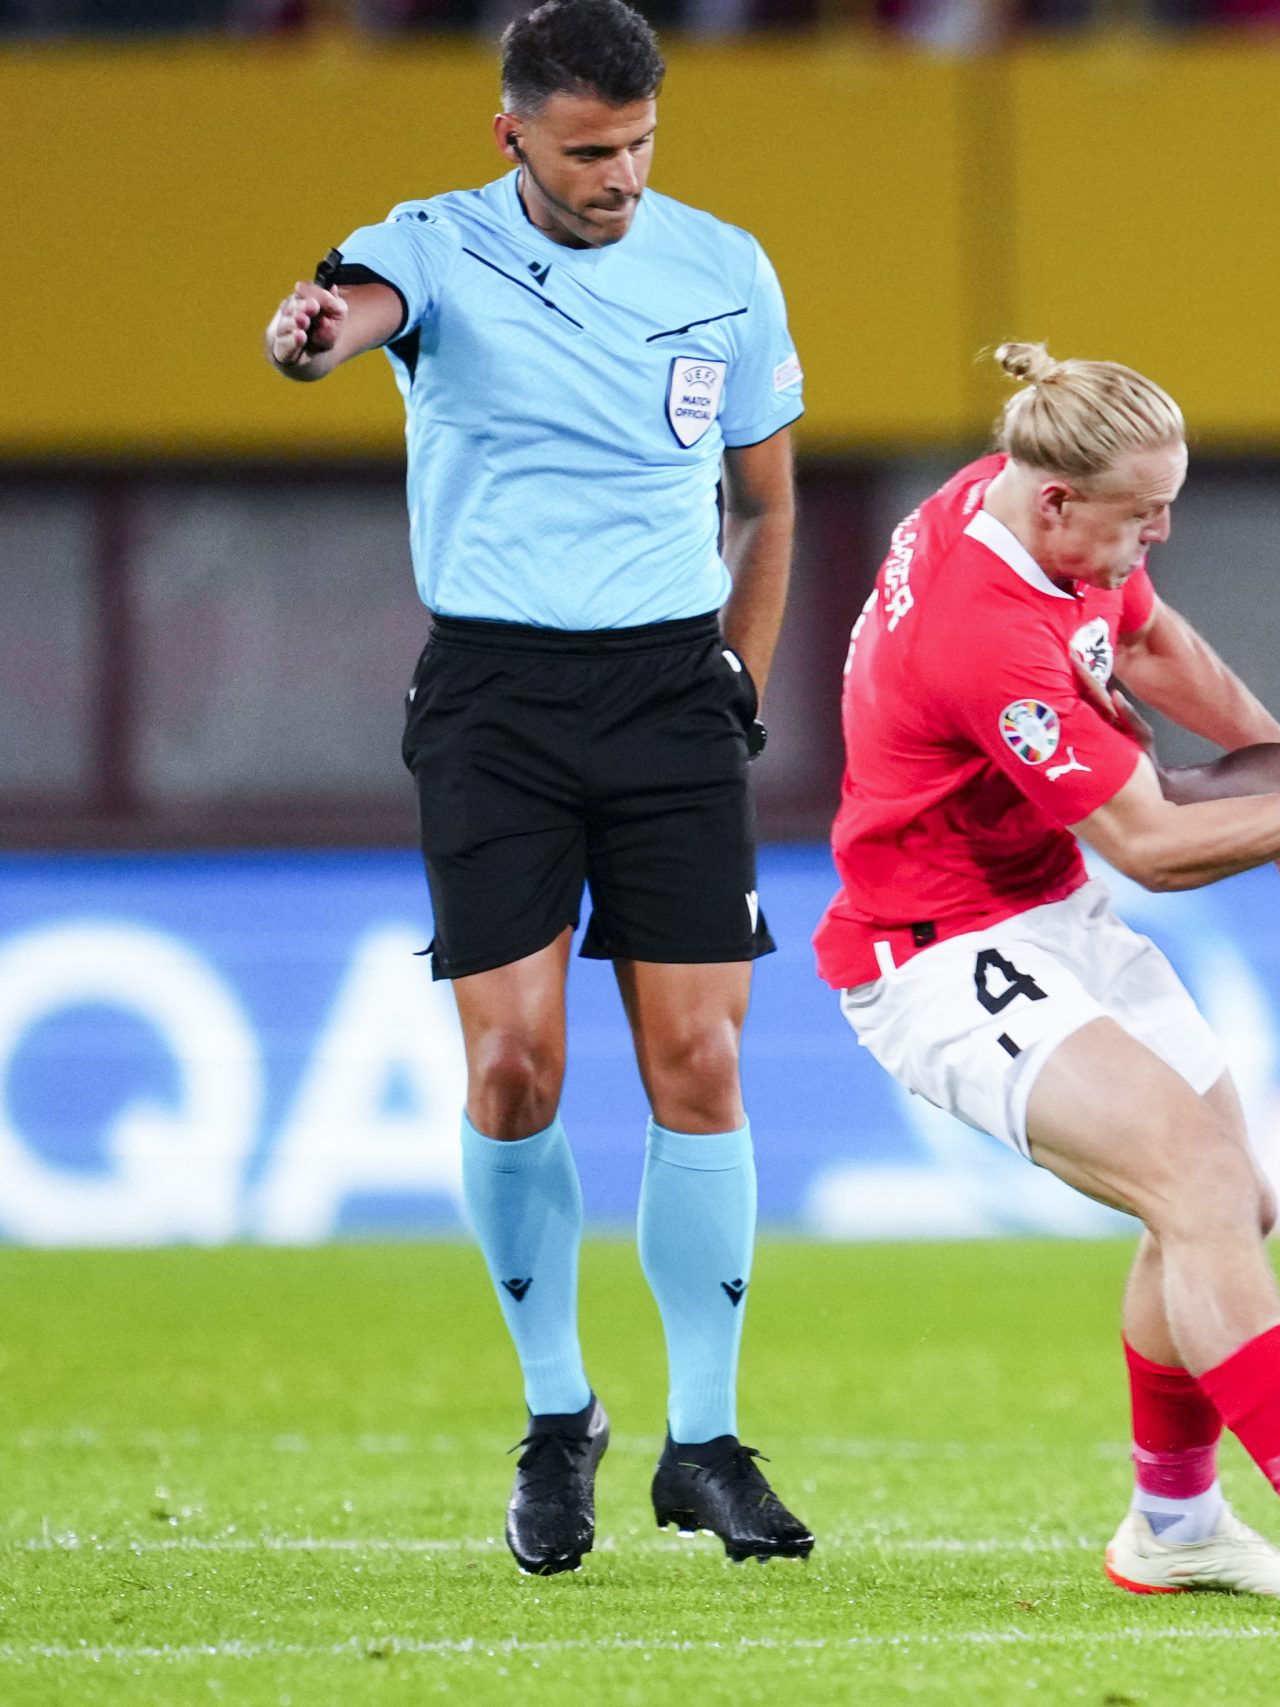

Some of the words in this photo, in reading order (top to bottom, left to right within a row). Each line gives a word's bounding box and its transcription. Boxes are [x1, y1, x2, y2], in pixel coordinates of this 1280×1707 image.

[683, 396, 710, 406] MATCH
[676, 408, 710, 420] OFFICIAL
[974, 948, 1048, 1060] 4
